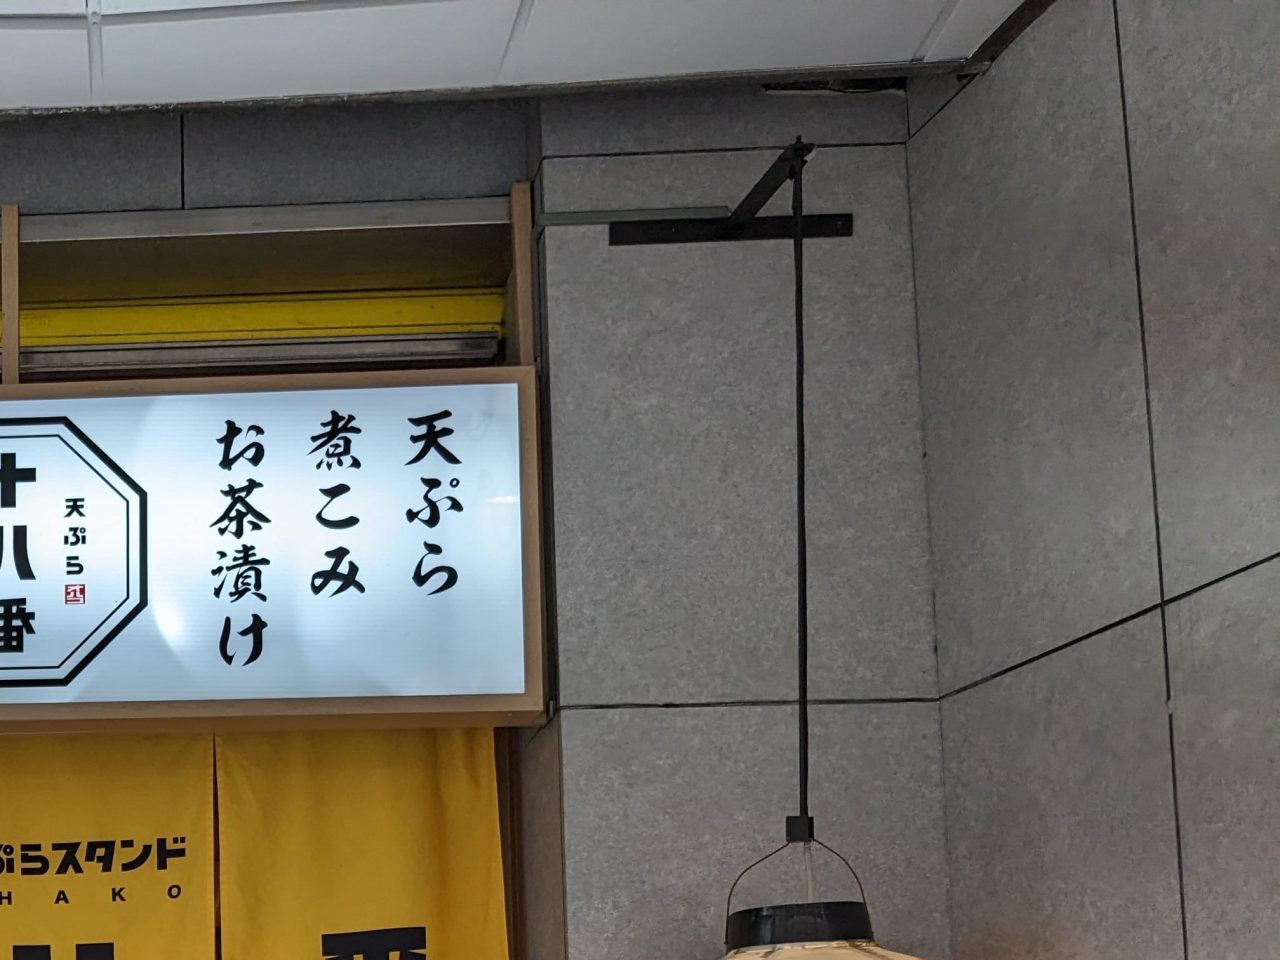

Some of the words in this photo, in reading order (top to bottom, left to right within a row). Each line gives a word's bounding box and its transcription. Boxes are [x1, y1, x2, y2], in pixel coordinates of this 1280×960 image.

[63, 497, 88, 576] 天ぷら
[210, 419, 272, 667] お茶漬け
[308, 409, 366, 597] 煮こみ
[405, 409, 464, 596] 天ぷら
